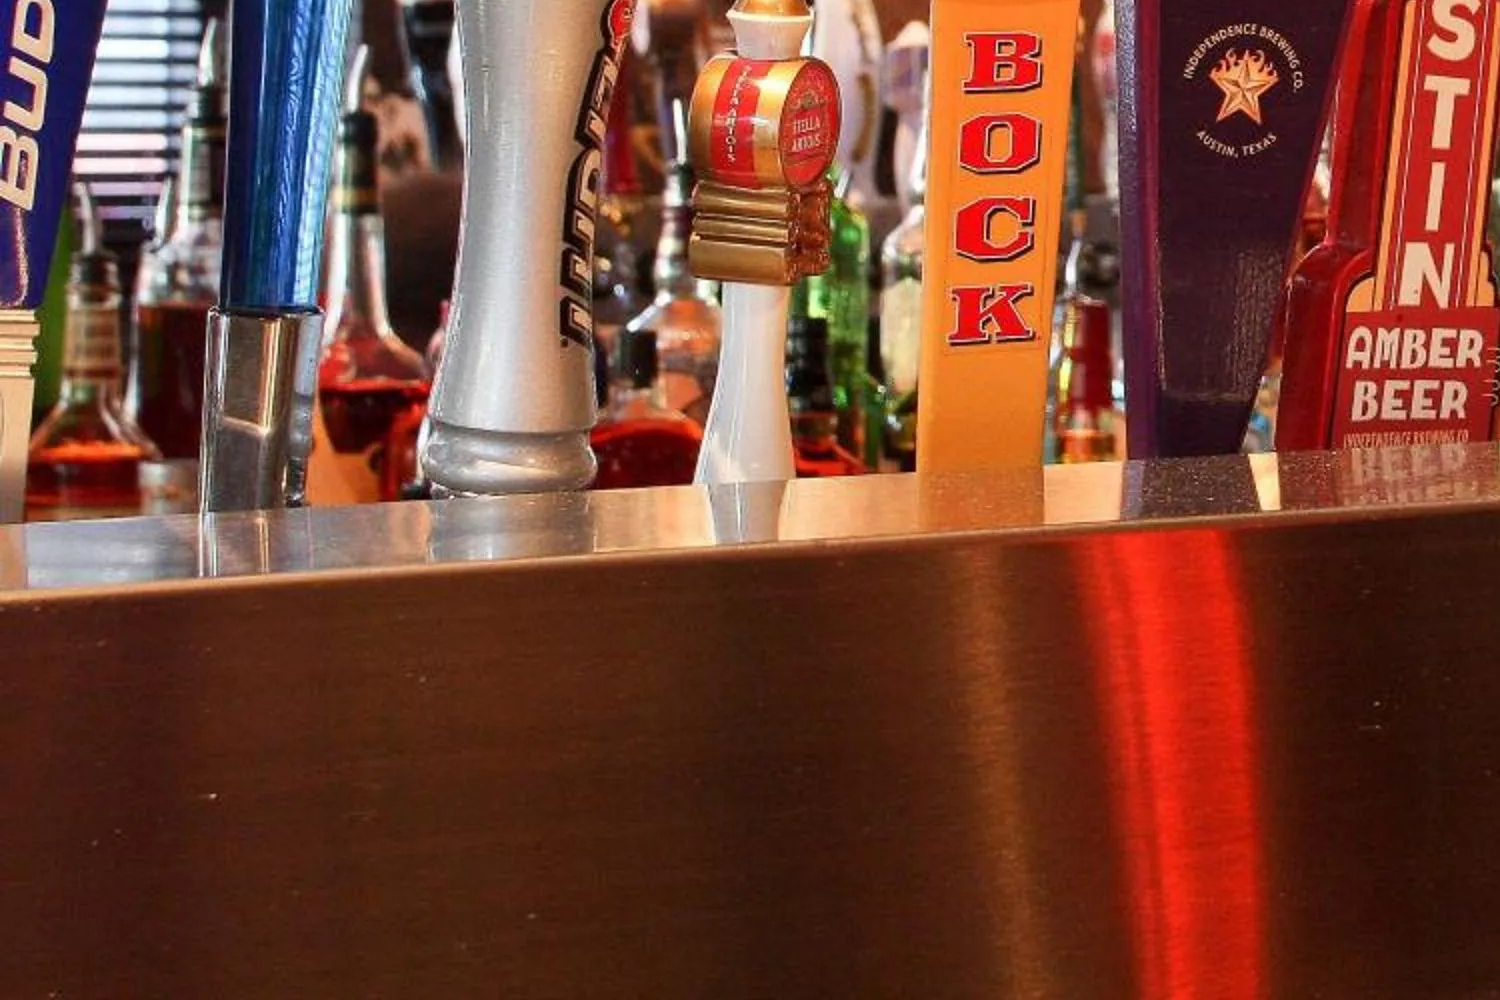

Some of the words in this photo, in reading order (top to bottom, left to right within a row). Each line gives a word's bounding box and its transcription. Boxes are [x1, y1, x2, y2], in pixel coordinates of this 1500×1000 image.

[1183, 23, 1257, 79] INDEPENDENCE
[1260, 25, 1301, 70] BREWING
[1242, 131, 1277, 156] TEXAS
[946, 31, 1043, 348] BOCK
[1345, 325, 1484, 370] AMBER
[1351, 379, 1469, 422] BEER
